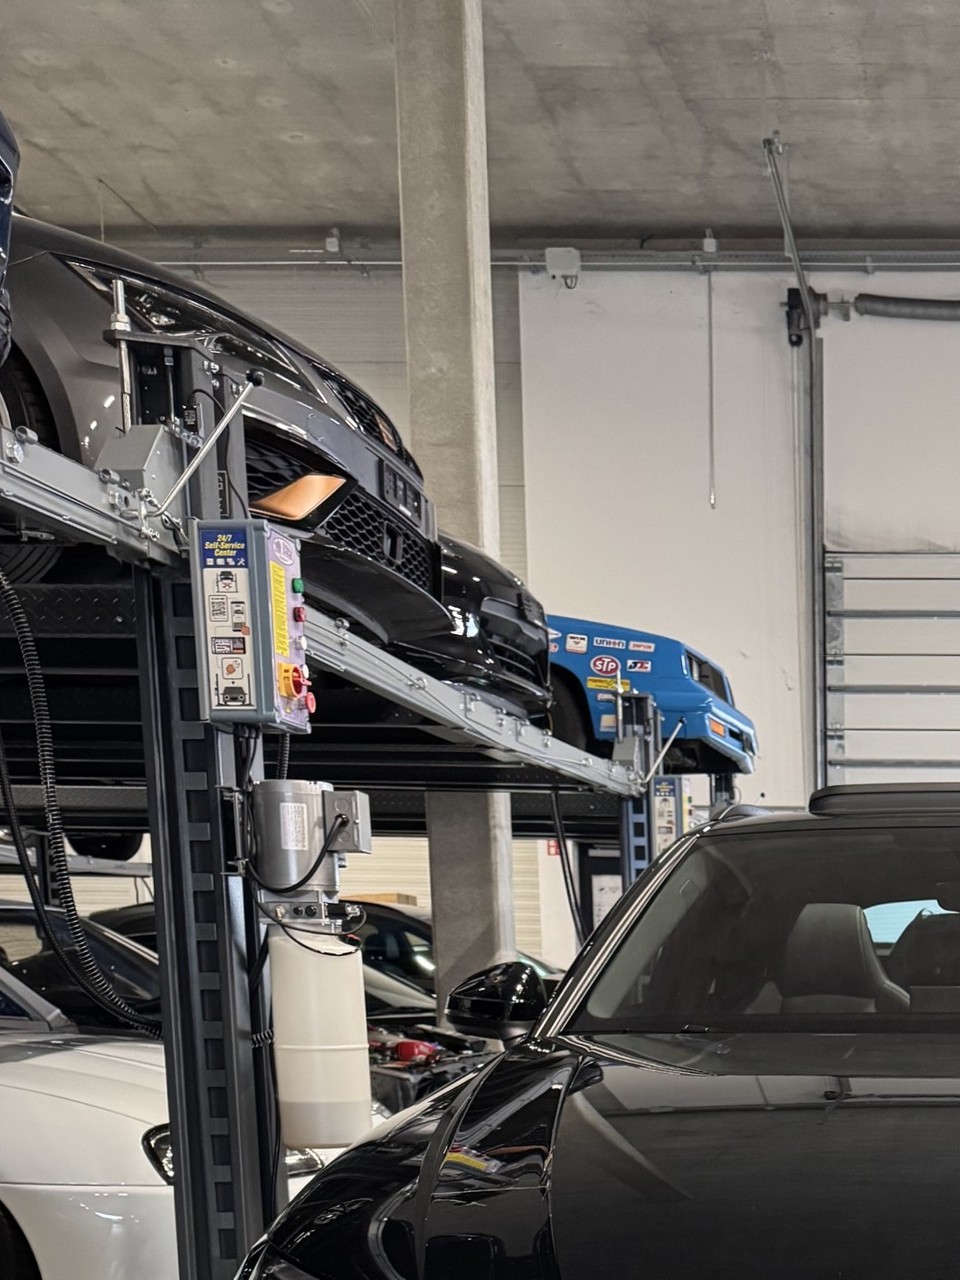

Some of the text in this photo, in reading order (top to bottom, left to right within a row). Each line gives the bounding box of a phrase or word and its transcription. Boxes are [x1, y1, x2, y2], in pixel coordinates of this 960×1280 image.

[217, 534, 232, 542] 24/7
[204, 541, 246, 550] Self-Service
[214, 549, 237, 557] Center
[595, 658, 617, 672] STP
